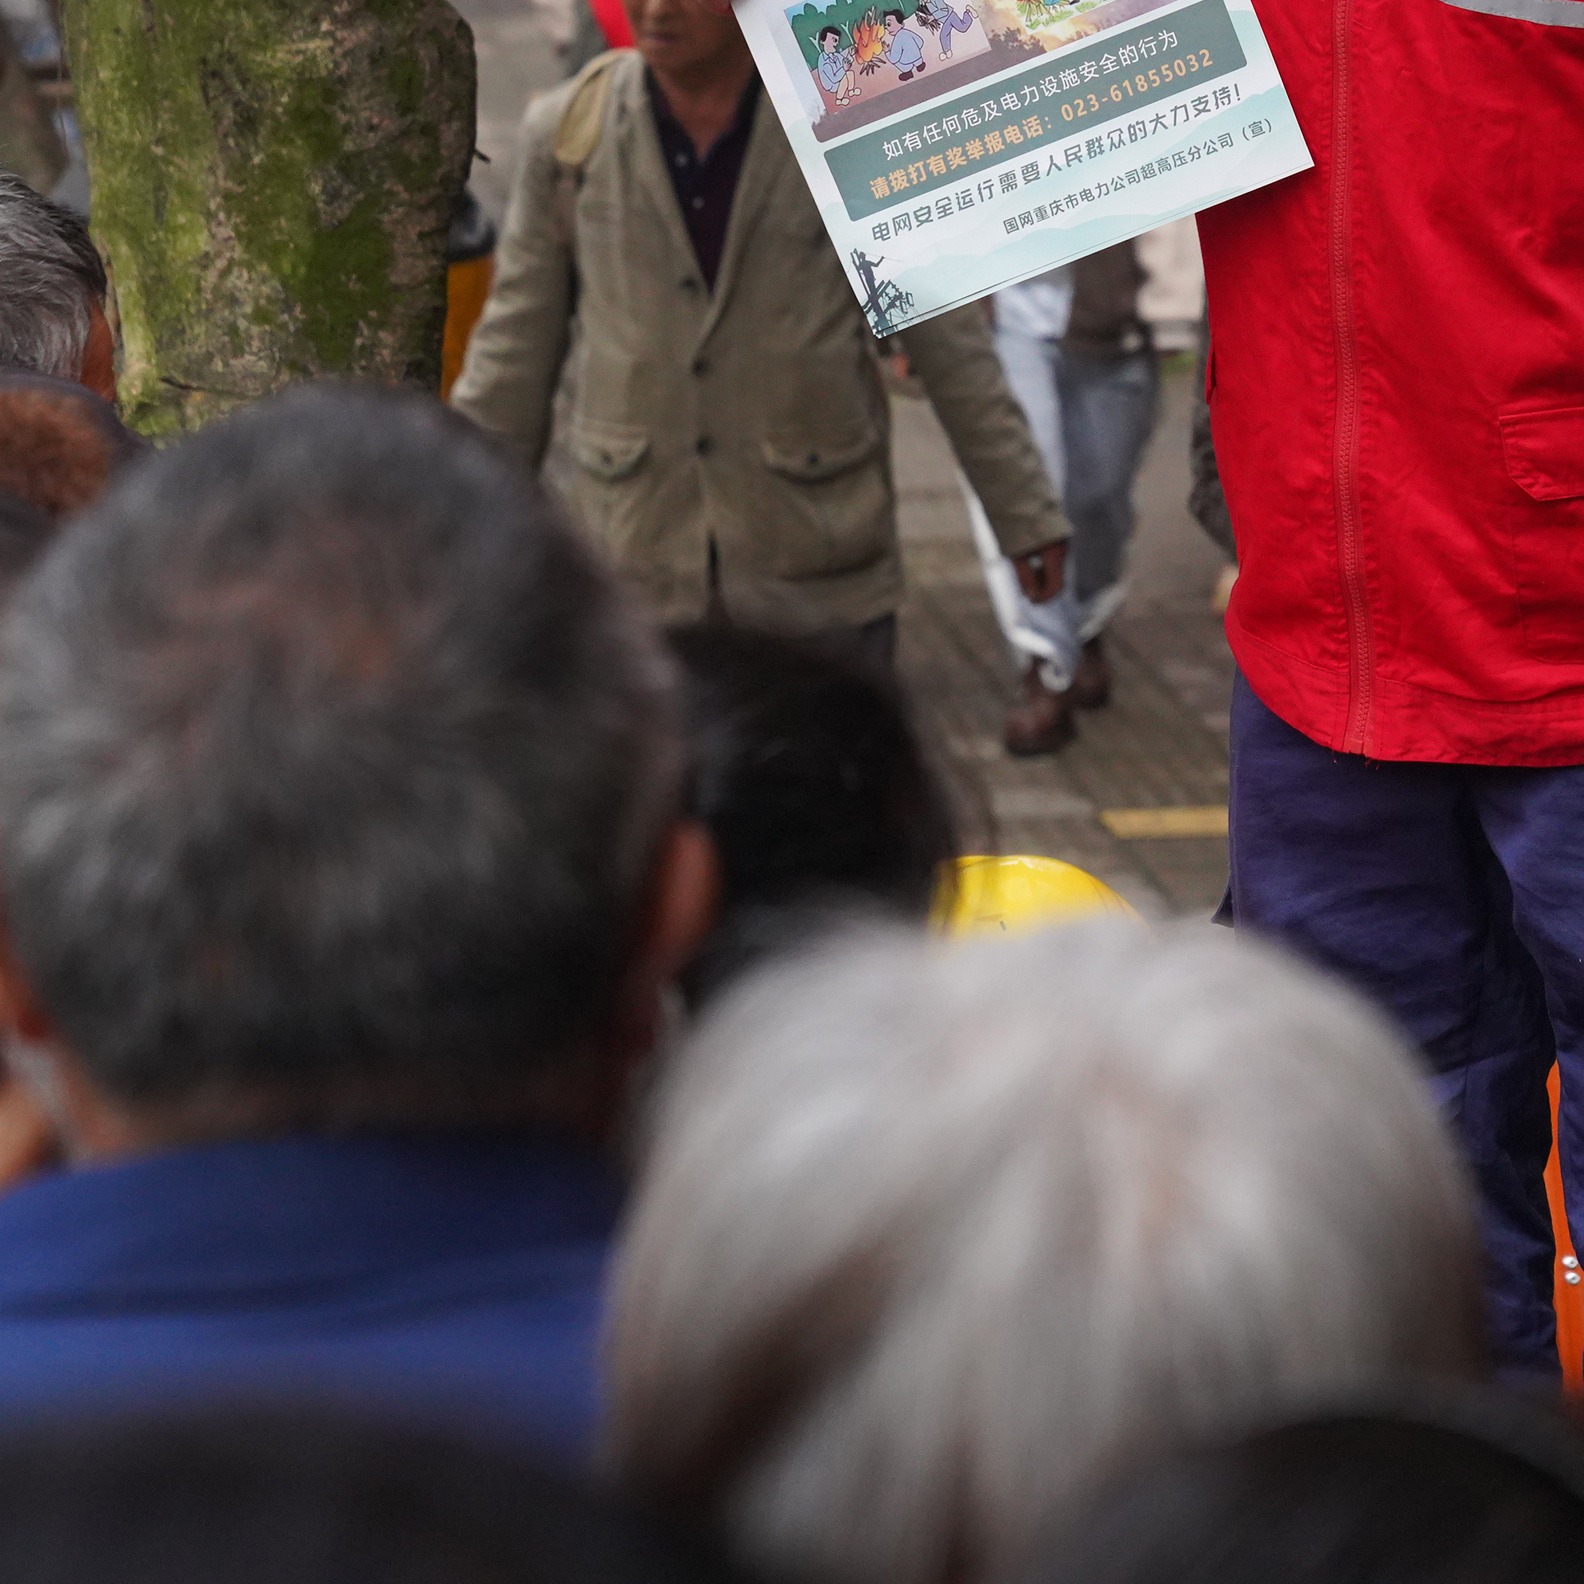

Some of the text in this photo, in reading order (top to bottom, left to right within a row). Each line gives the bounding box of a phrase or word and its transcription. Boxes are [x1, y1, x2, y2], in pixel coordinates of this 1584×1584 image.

[867, 46, 1216, 201] 请拨打有奖举报电话：023-61855032
[868, 80, 1245, 245] 电网安全运行需要人民群众的大力支持！
[879, 27, 1181, 161] 如有任何危及电力设施安全的行为
[1001, 115, 1275, 236] 国网重庆市电力公司超高压分公司（宣）
